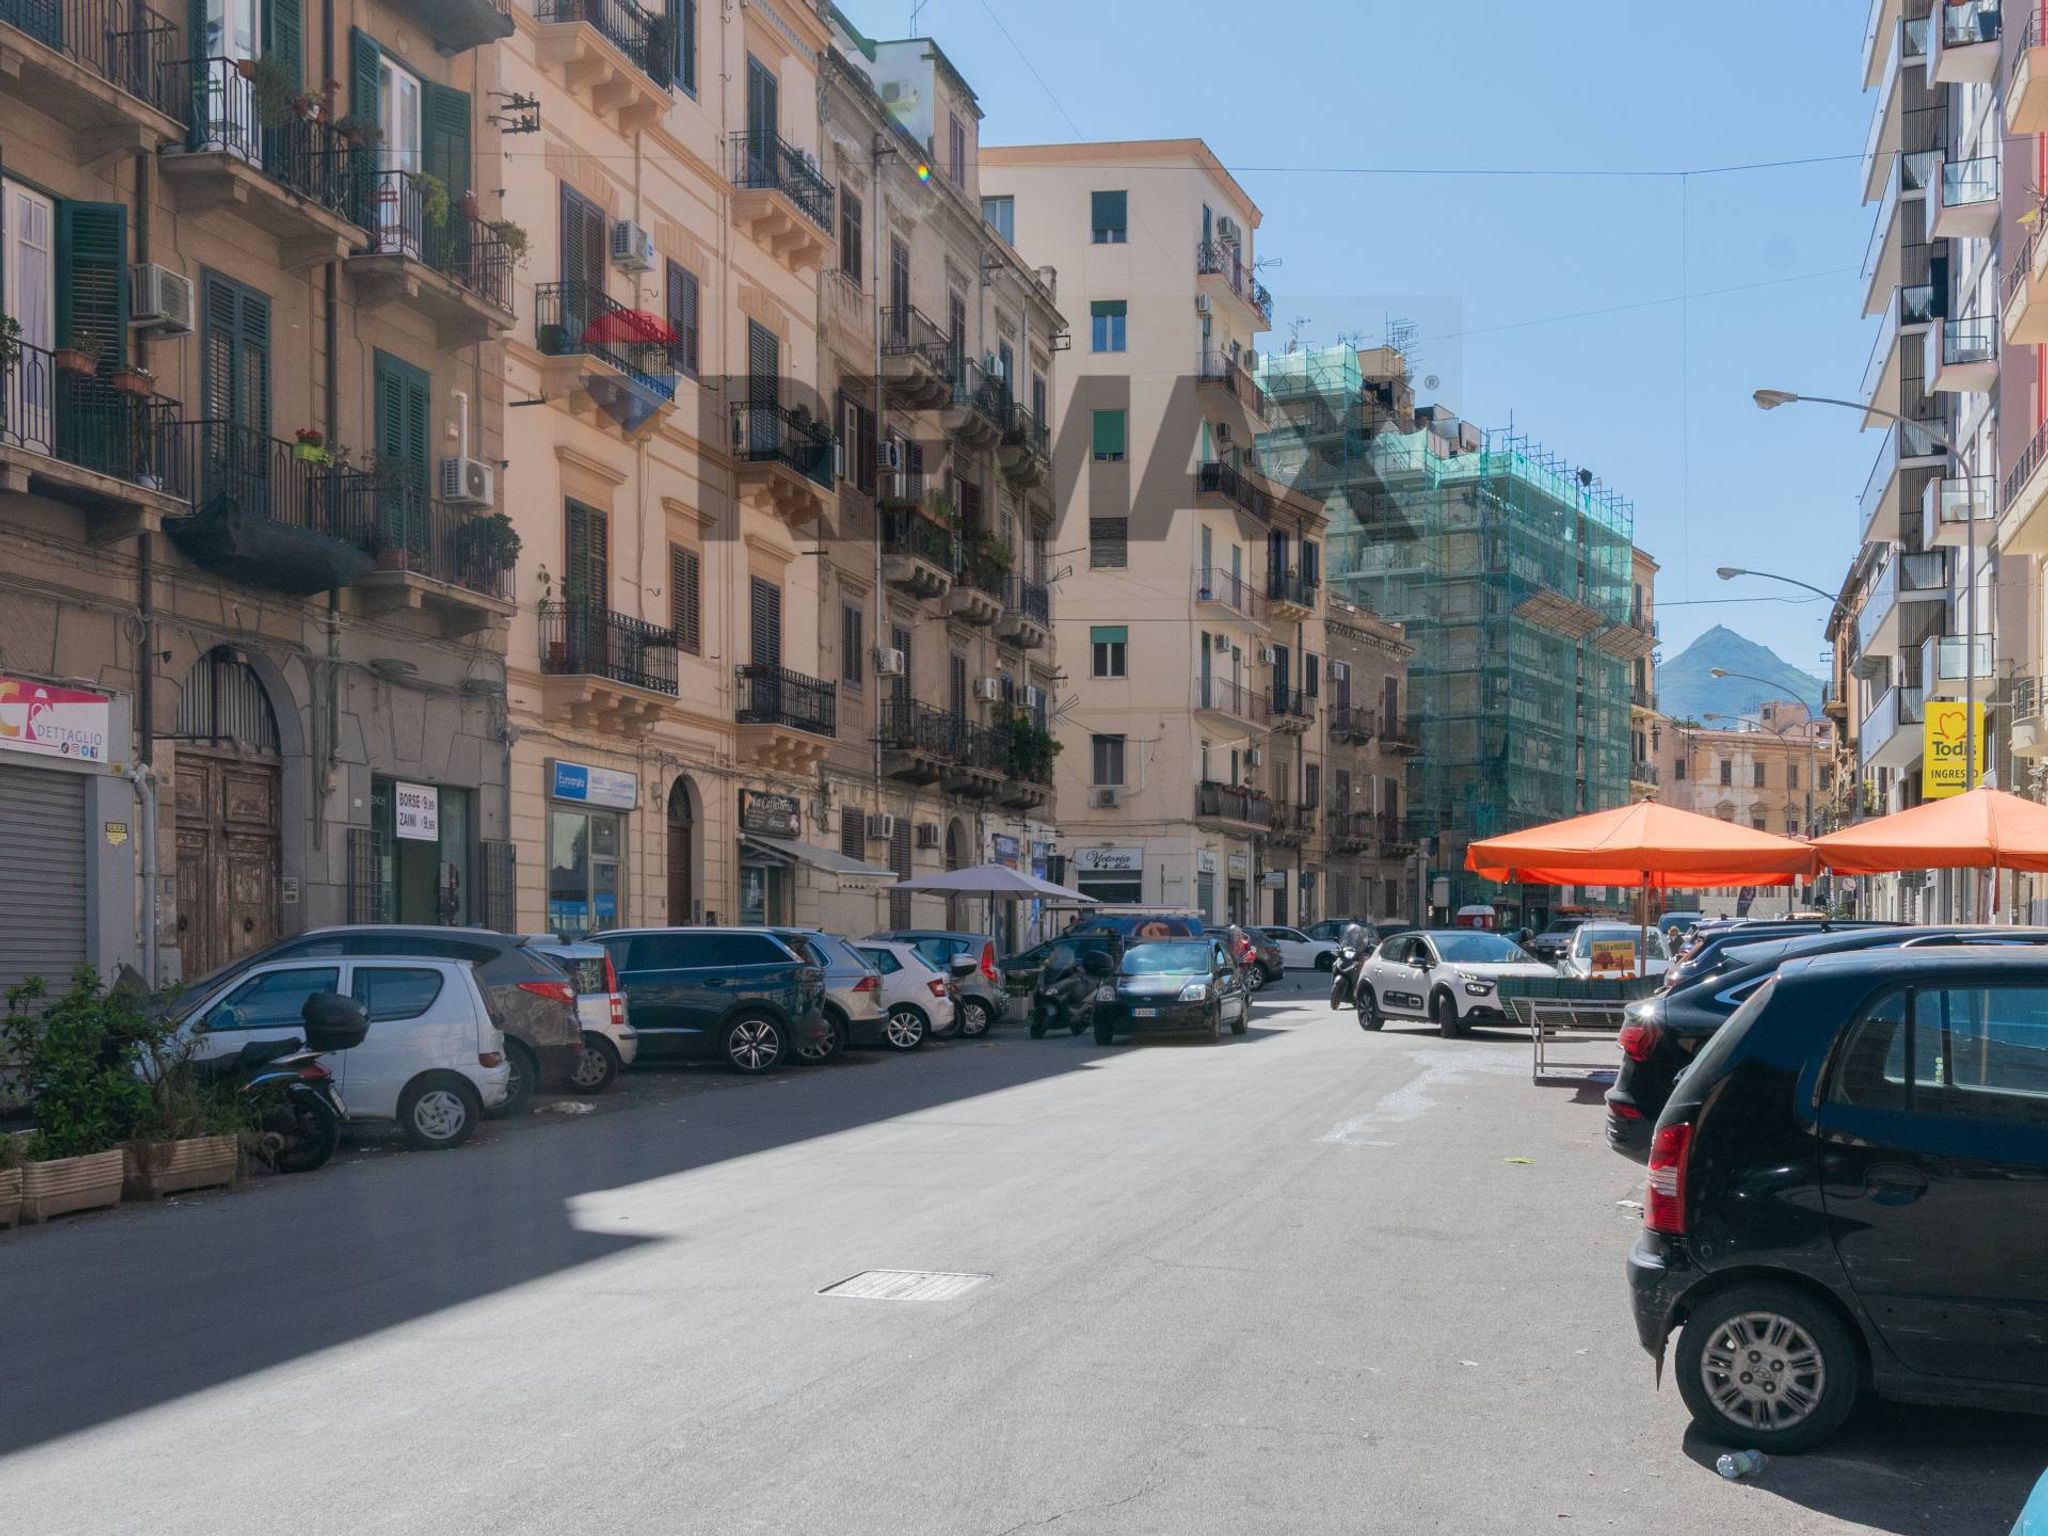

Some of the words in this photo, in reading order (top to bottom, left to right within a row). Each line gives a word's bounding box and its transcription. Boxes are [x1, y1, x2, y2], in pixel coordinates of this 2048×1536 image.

[37, 724, 102, 746] DETTAGLIO
[1931, 769, 1979, 779] INGRESO
[399, 792, 420, 808] BORSE
[399, 812, 417, 827] ZAINI
